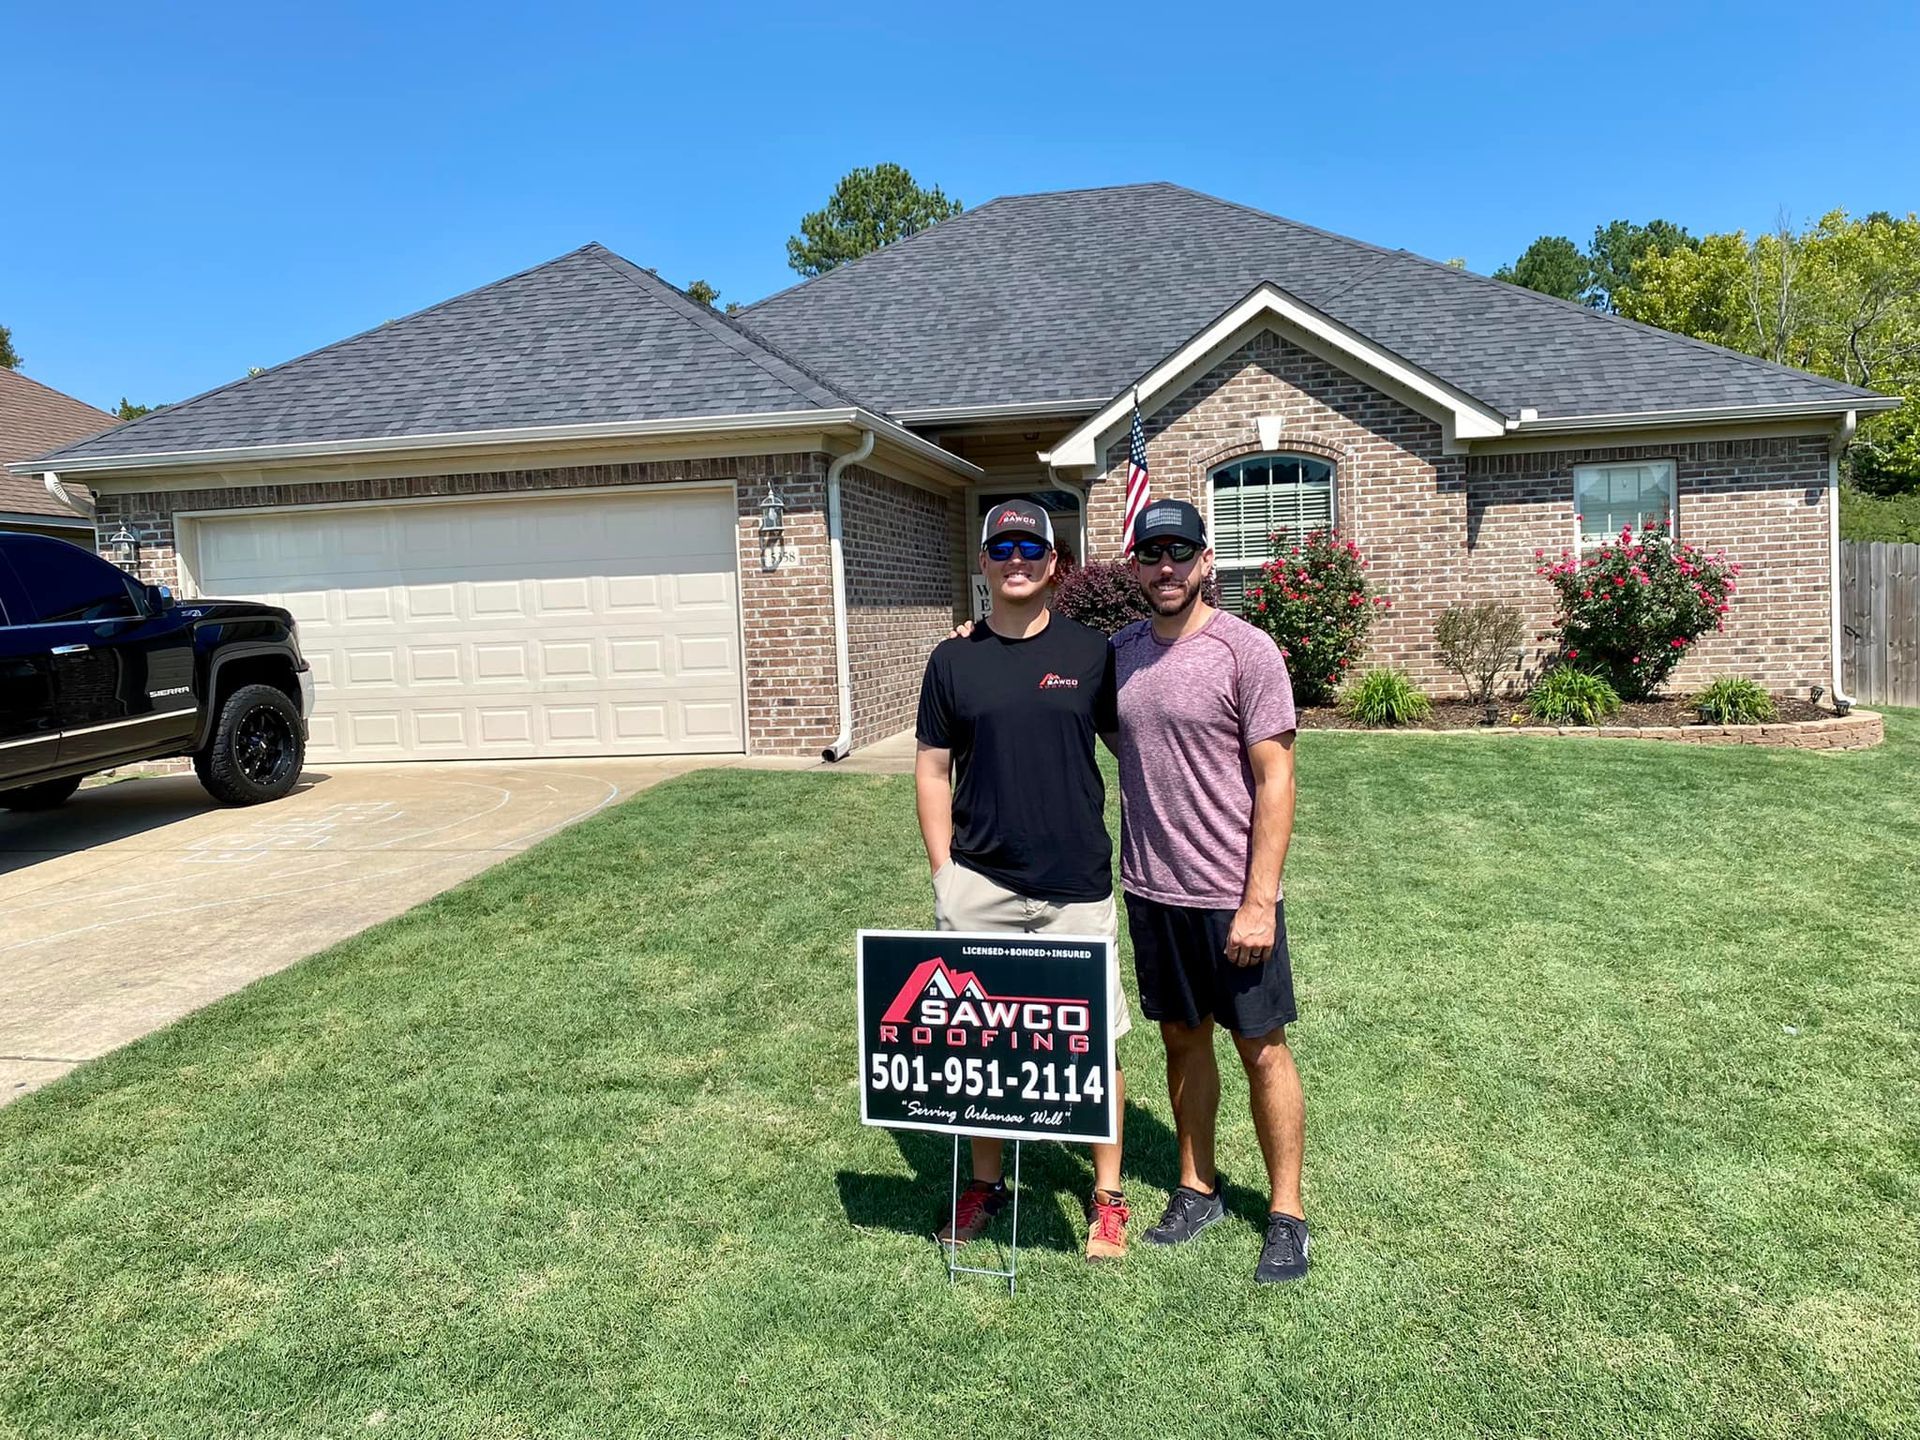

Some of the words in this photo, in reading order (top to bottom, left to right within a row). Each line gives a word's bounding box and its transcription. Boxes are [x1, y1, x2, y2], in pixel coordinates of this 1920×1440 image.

[149, 686, 190, 698] SIERRA
[920, 1000, 1090, 1032] SAWCO
[880, 1025, 1090, 1053] ROOFING
[871, 1053, 1105, 1104] 501-951-2114
[901, 1100, 958, 1123] "Serving
[964, 1104, 1026, 1124] Arkansas
[1030, 1109, 1072, 1126] Well"
